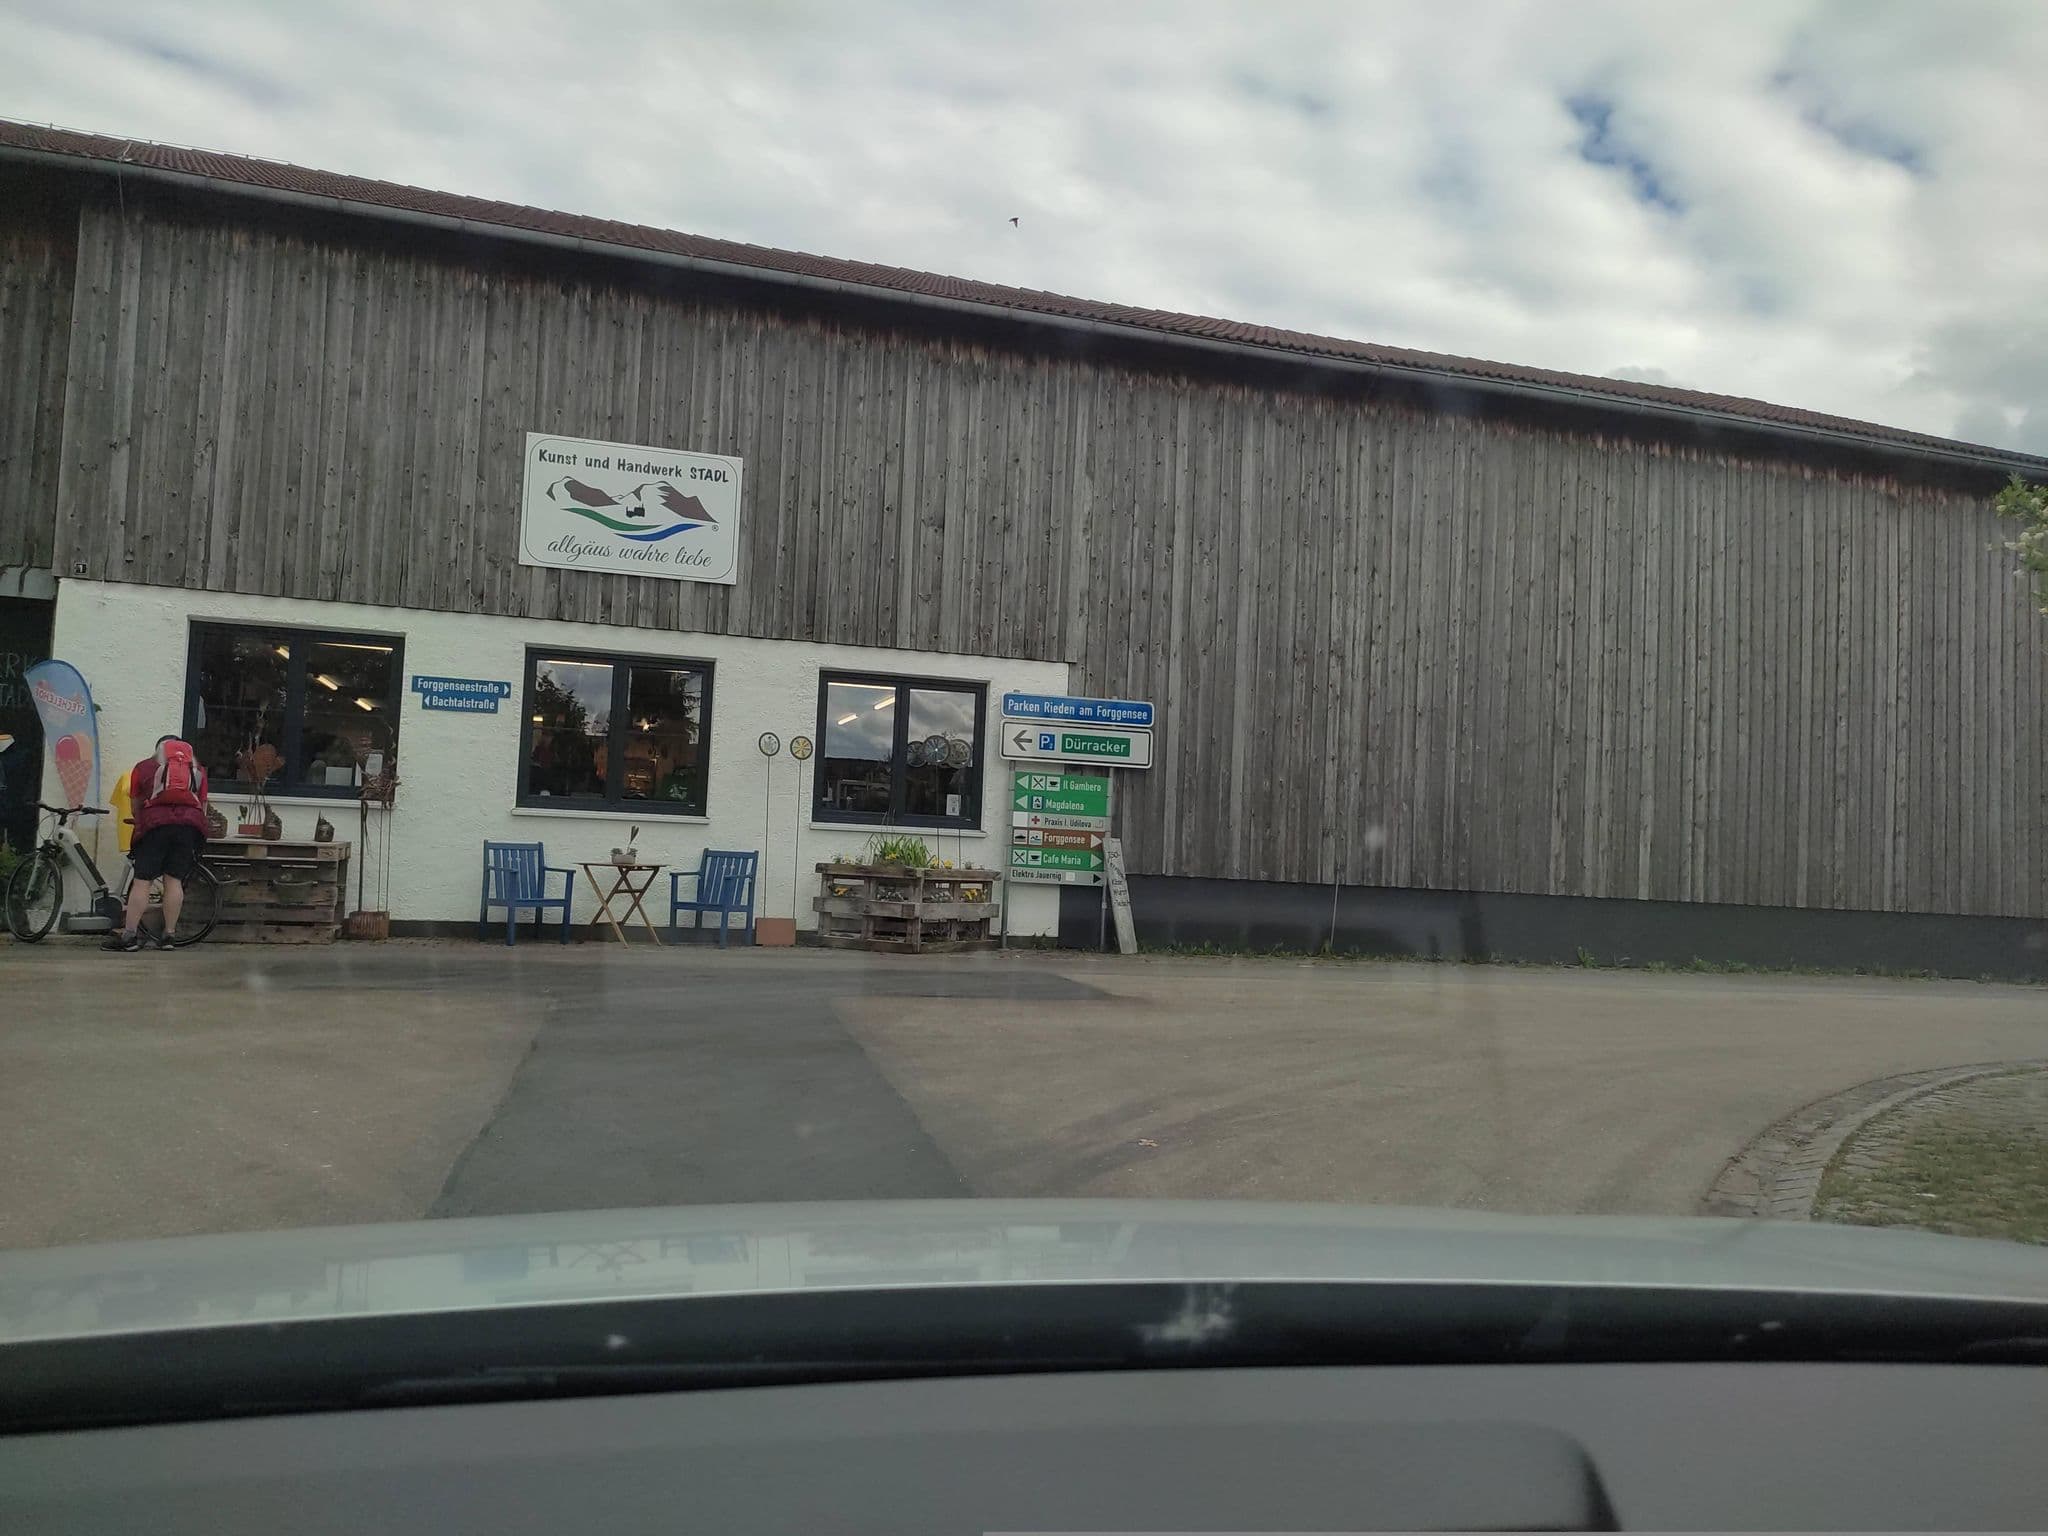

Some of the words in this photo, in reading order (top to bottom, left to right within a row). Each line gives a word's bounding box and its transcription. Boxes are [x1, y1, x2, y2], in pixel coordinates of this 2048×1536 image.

[538, 449, 578, 466] Kunst
[585, 456, 610, 470] und
[617, 458, 682, 478] Handwerk
[690, 467, 729, 483] STADL
[547, 535, 613, 562] allgäus
[619, 544, 670, 563] wahre
[674, 547, 712, 568] liebe
[417, 678, 500, 694] Forggenseestraße
[432, 695, 495, 710] Bachtalstraße
[1008, 699, 1040, 713] Parken
[1044, 701, 1075, 716] Rieden
[1079, 706, 1093, 717] am
[1096, 706, 1148, 721] Forggensee
[1065, 737, 1127, 753] Dürracker
[1069, 780, 1102, 792] Gambero
[1045, 798, 1085, 811] Magdalena
[1044, 817, 1063, 827] Praxis
[1044, 832, 1086, 846] Forggensee
[1043, 854, 1059, 865] Cafe
[1061, 854, 1082, 865] Maria
[1012, 869, 1034, 878] Elektro
